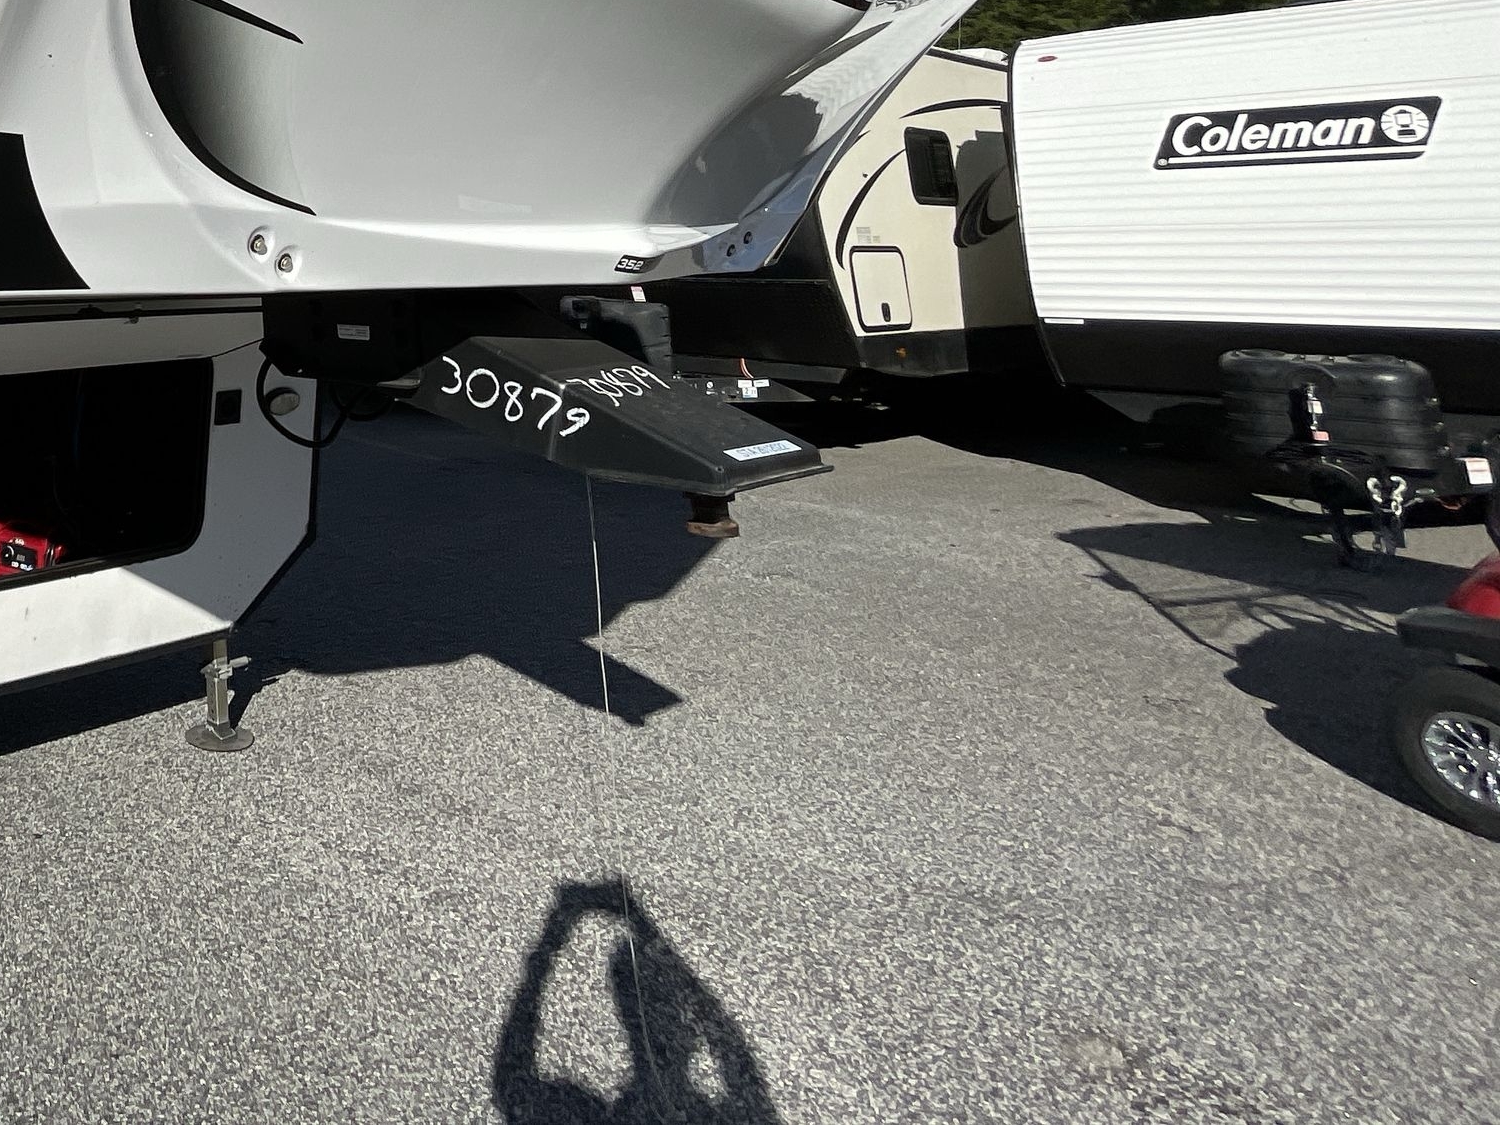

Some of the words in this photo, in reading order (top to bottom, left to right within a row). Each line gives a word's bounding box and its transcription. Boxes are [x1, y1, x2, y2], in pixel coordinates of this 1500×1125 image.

[1171, 113, 1375, 157] Coleman
[616, 258, 644, 271] 352
[441, 356, 590, 438] 30879
